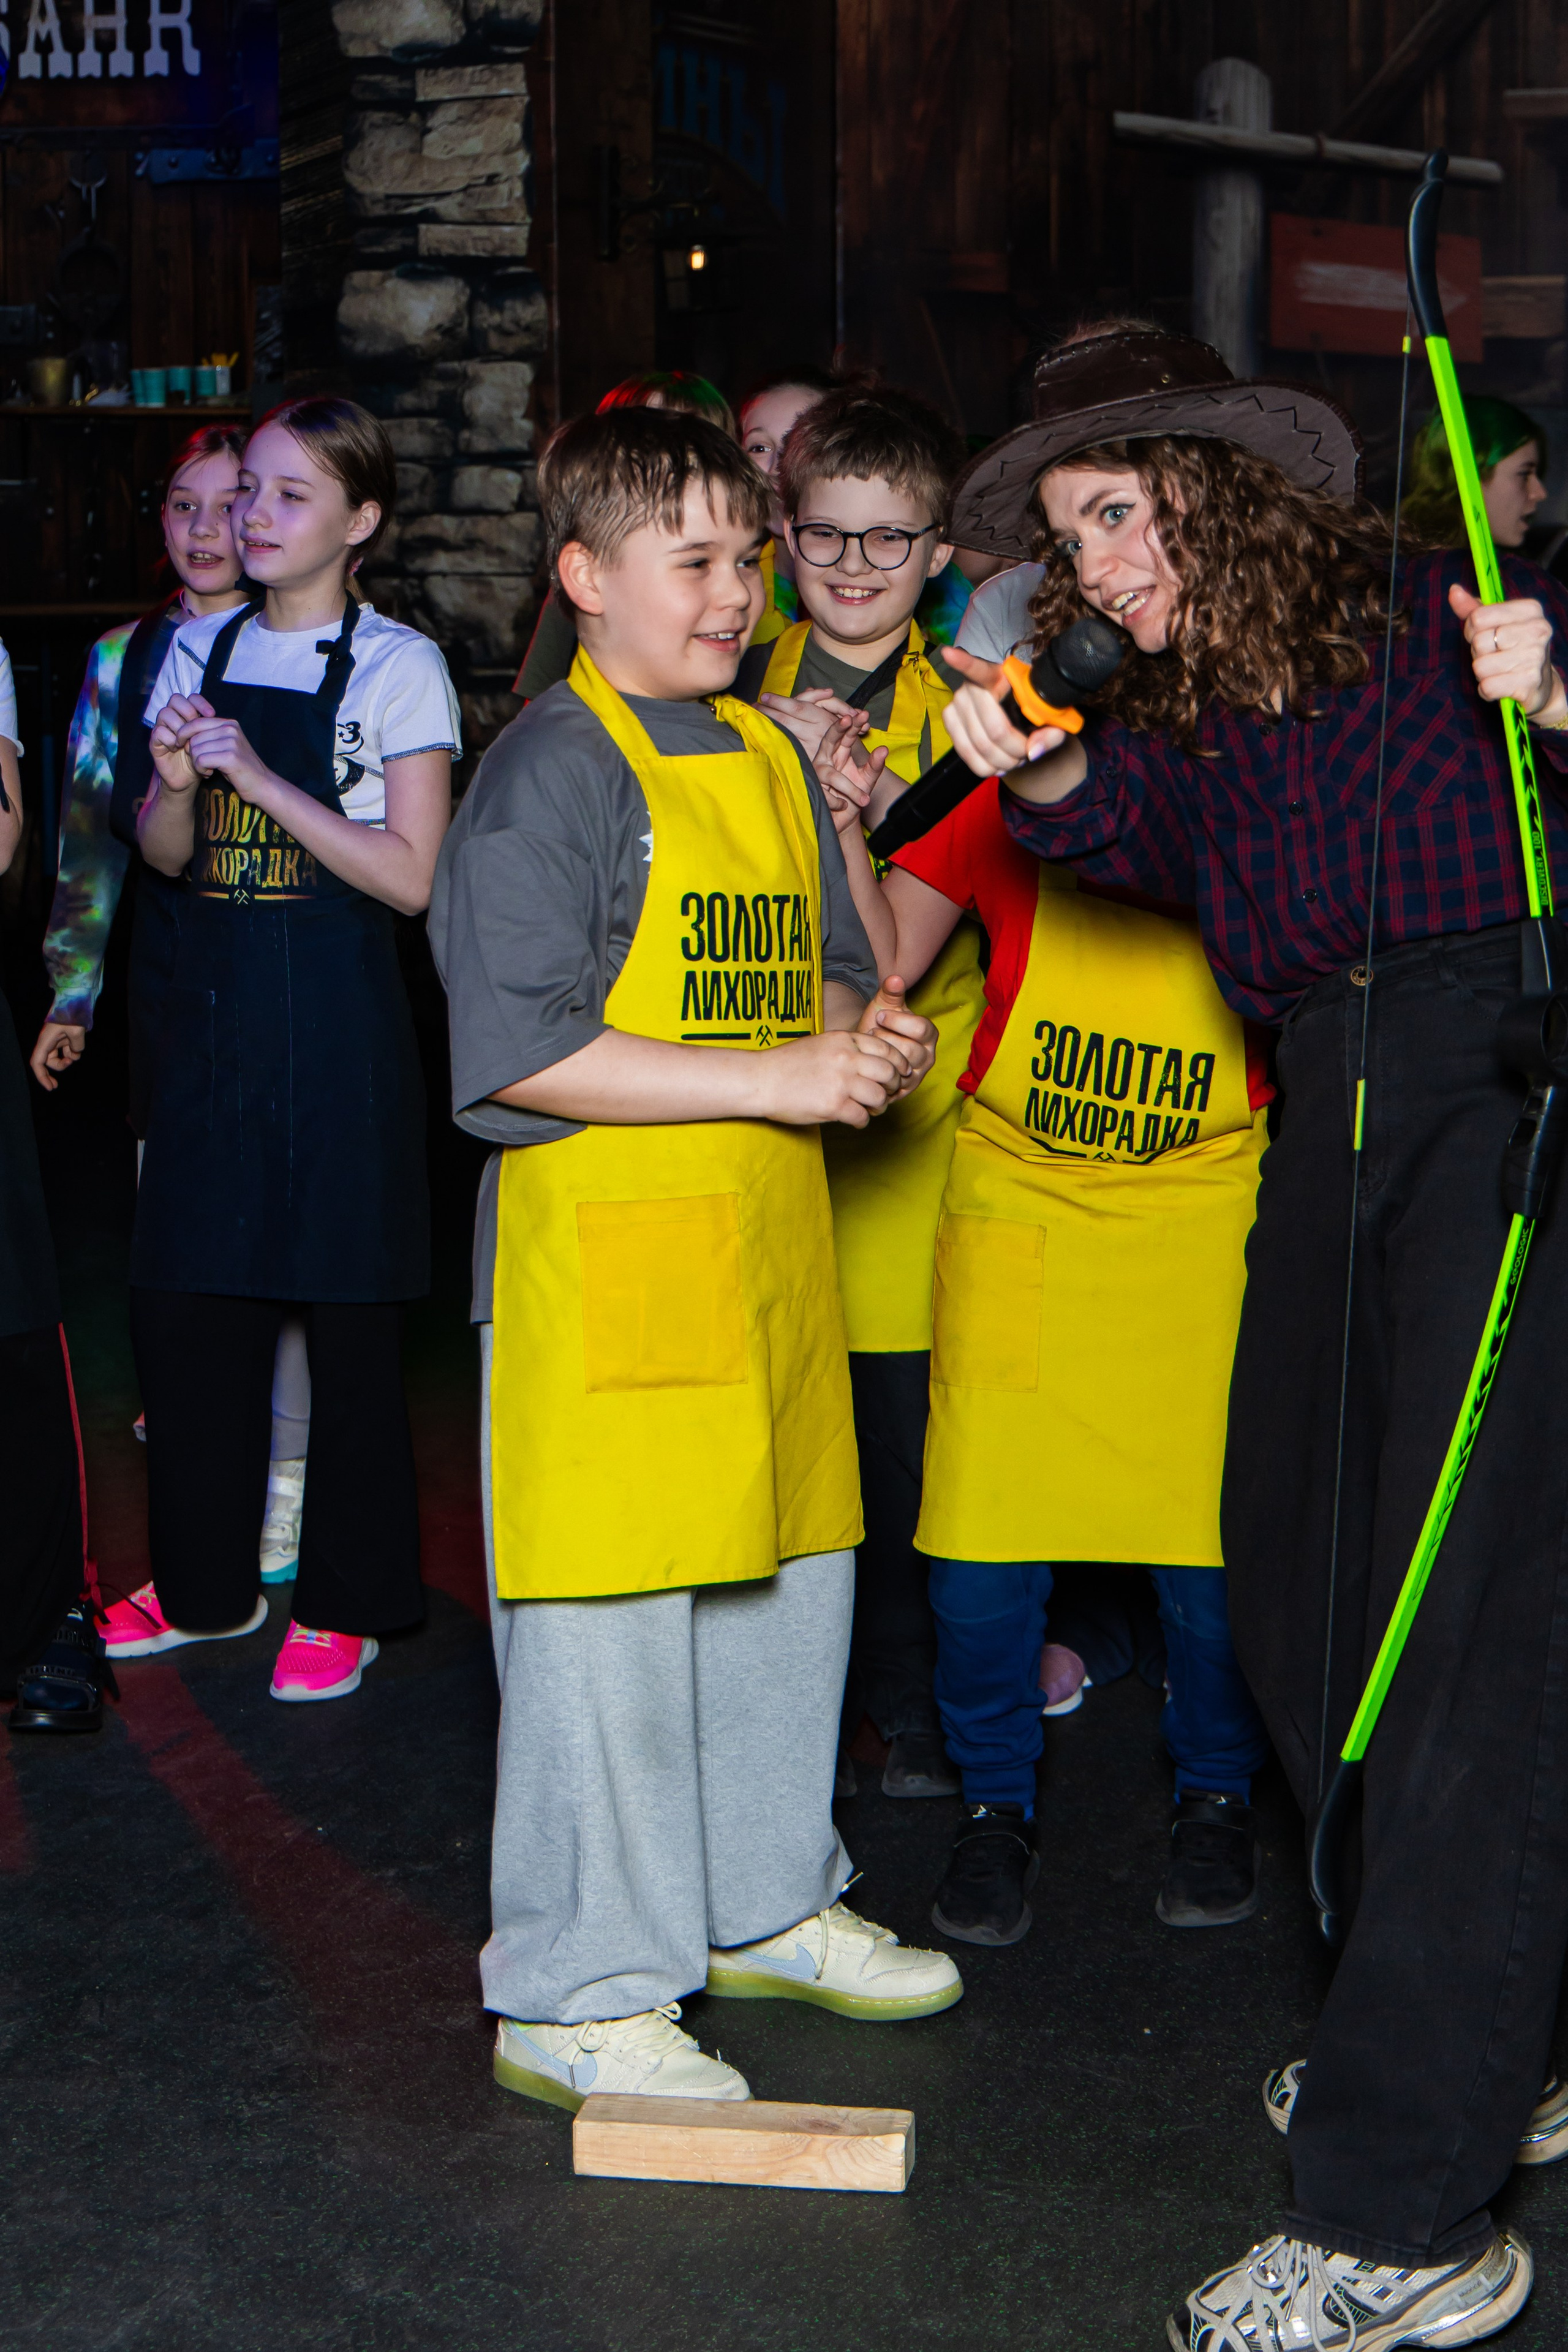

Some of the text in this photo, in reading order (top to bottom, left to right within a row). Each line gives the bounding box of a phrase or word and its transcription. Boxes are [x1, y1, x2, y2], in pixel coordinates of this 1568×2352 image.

[1532, 831, 1542, 850] 100
[680, 970, 812, 1022] ЛИХОРАДКА
[1031, 1020, 1216, 1112] ЗОЛОТАЯ
[1024, 1087, 1200, 1156] ЛИХОРАДКА
[1510, 1227, 1529, 1285] GEOLOGIC
